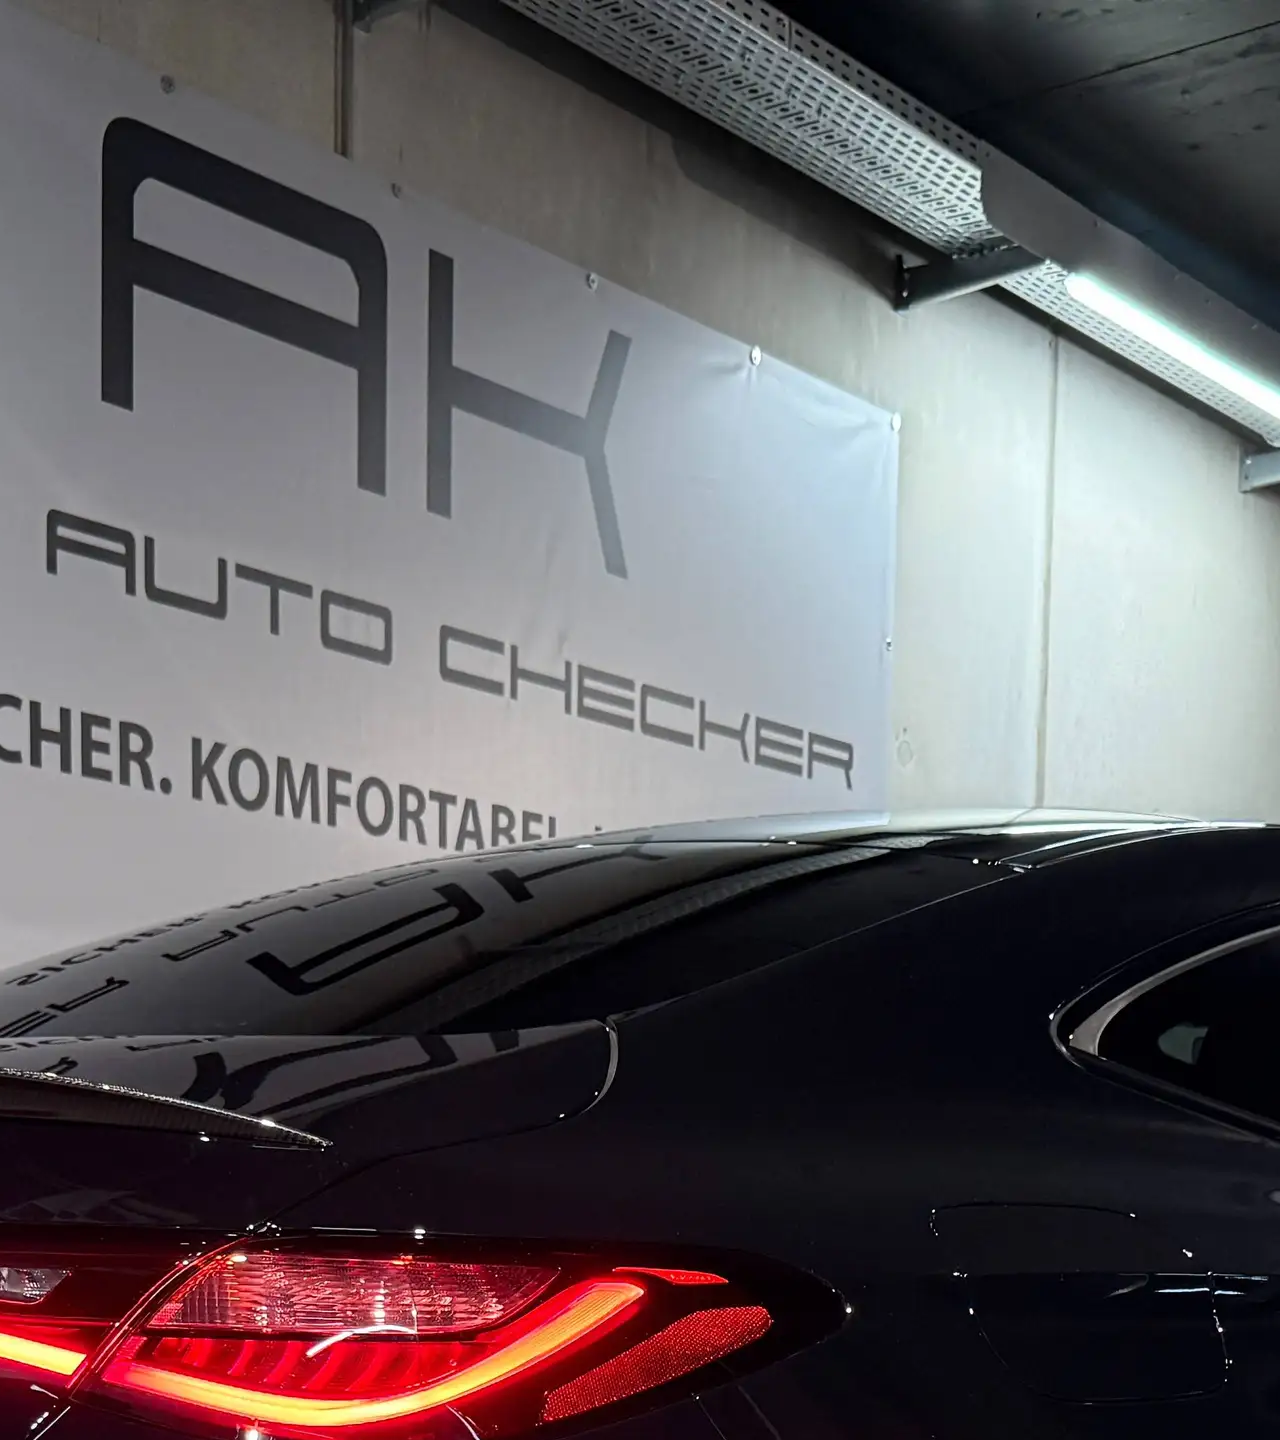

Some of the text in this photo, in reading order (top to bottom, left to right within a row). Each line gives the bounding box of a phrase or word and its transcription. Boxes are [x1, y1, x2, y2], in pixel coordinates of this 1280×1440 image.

[101, 116, 632, 579] AK
[46, 508, 393, 666] AUTO
[439, 624, 854, 791] CHECKER
